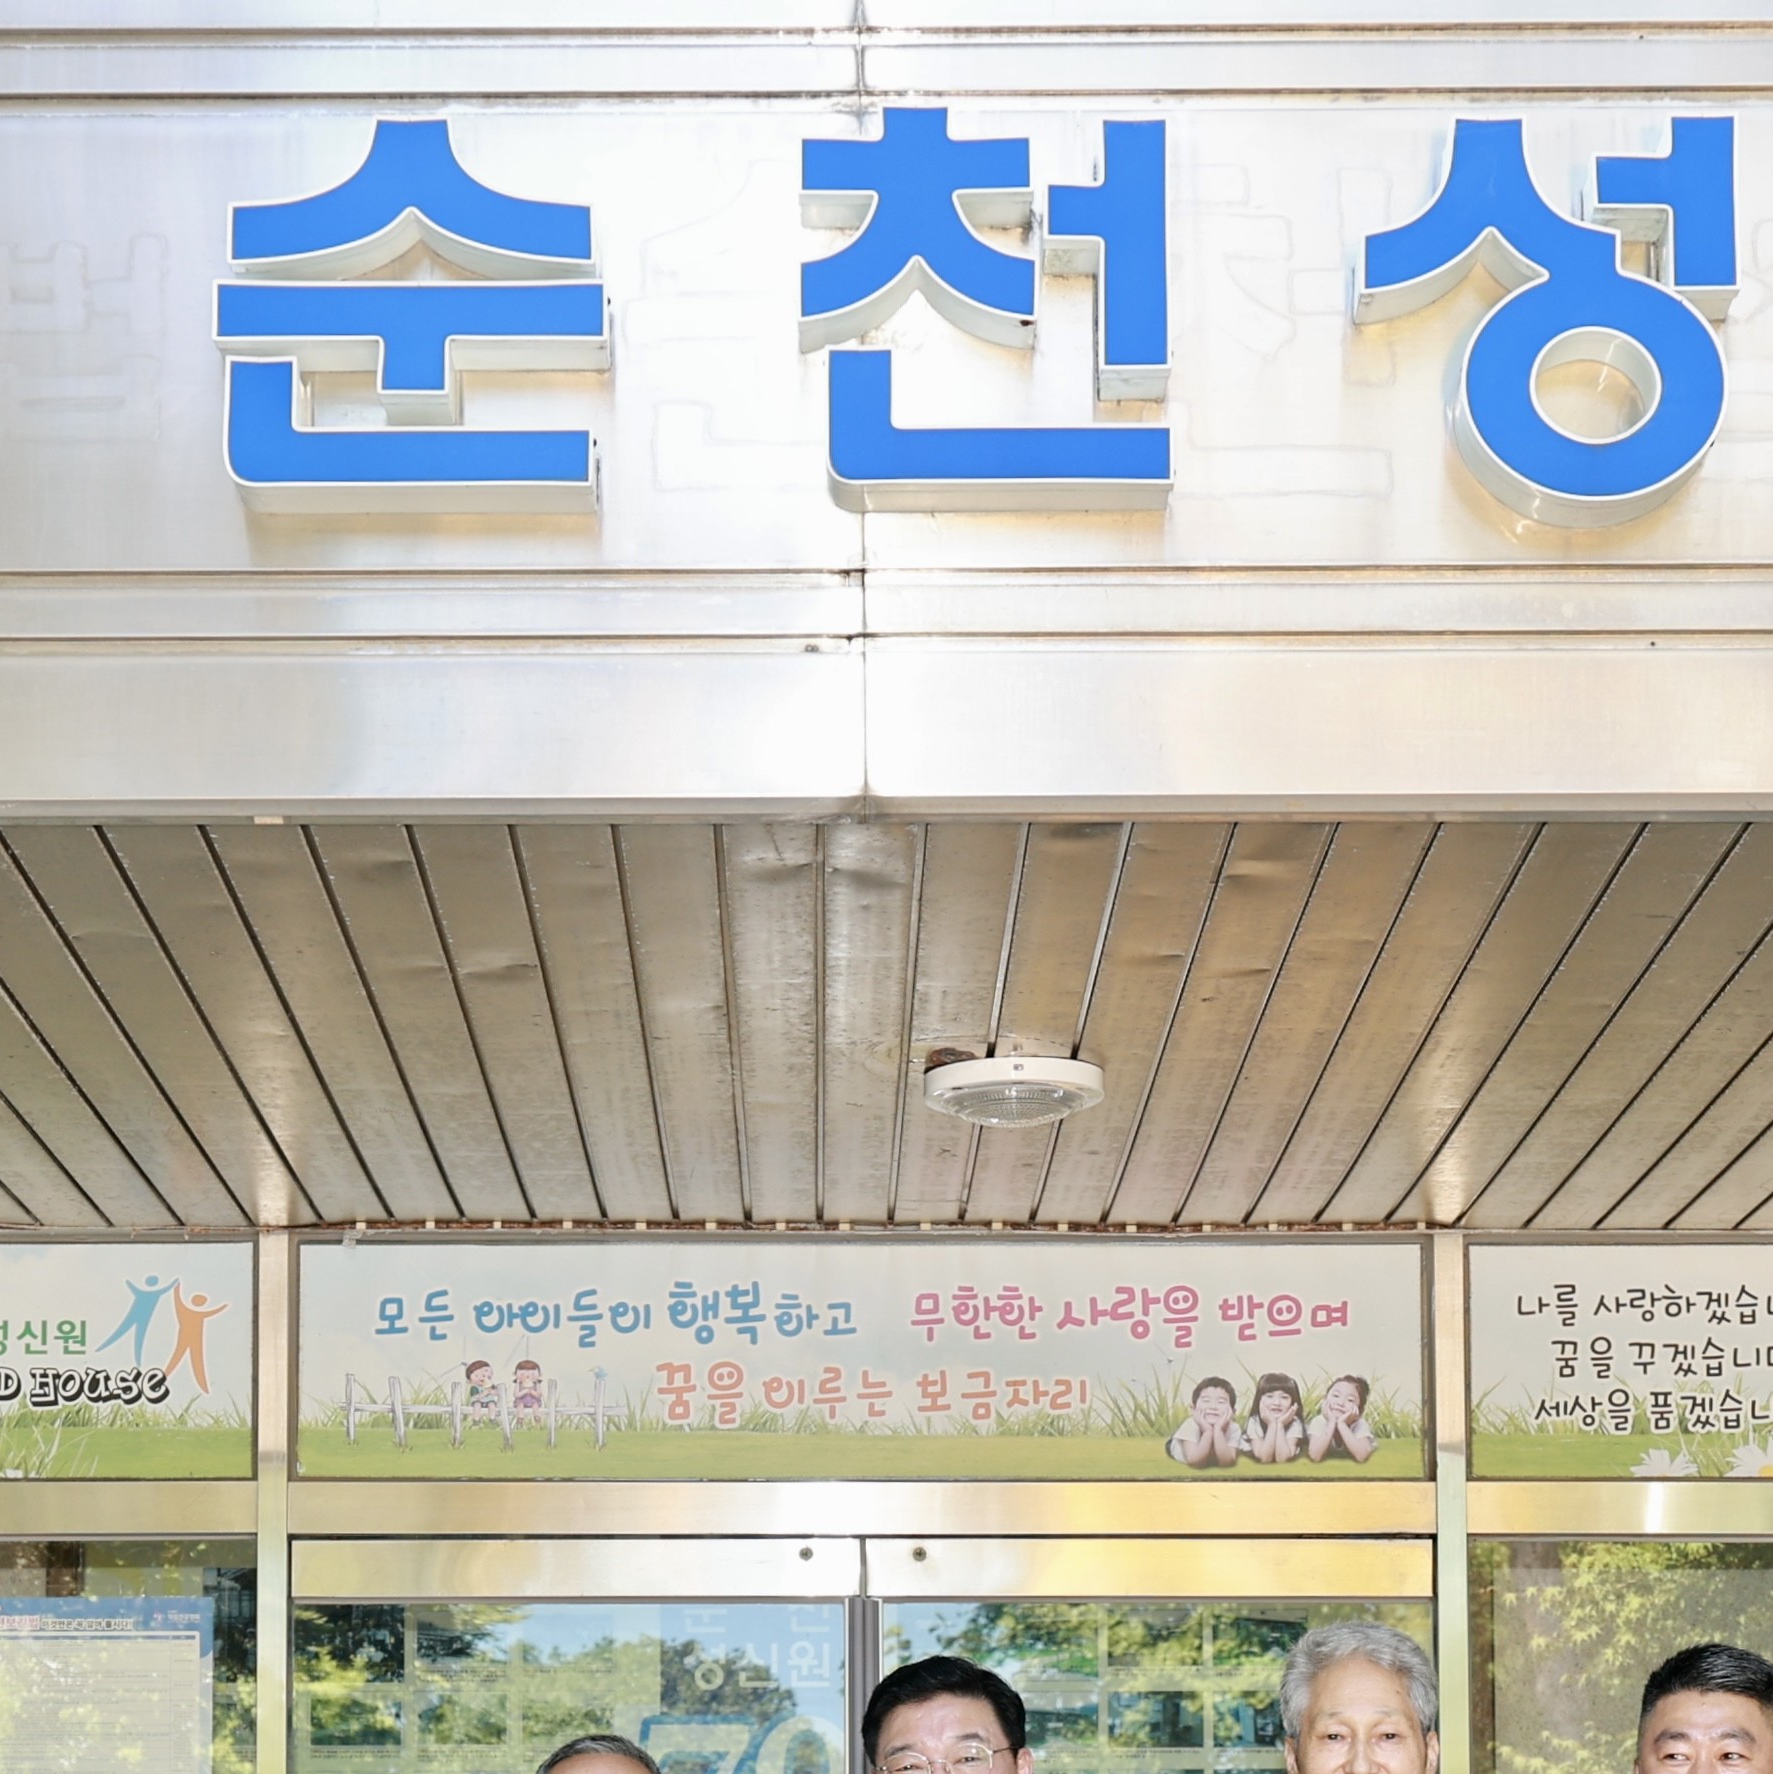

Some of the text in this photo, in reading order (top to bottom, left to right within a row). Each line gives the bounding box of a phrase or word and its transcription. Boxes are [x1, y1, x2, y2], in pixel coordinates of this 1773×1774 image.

[375, 1281, 1349, 1348] 모든 아이들이 행복하고 무한한 사랑을 받으며
[1516, 1284, 1578, 1326] 나를
[1551, 1336, 1614, 1378] 꿈을
[656, 1361, 1087, 1424] 꿈을 이루는 보금자리
[1534, 1389, 1632, 1430] 세상을
[683, 1641, 830, 1690] 성신원
